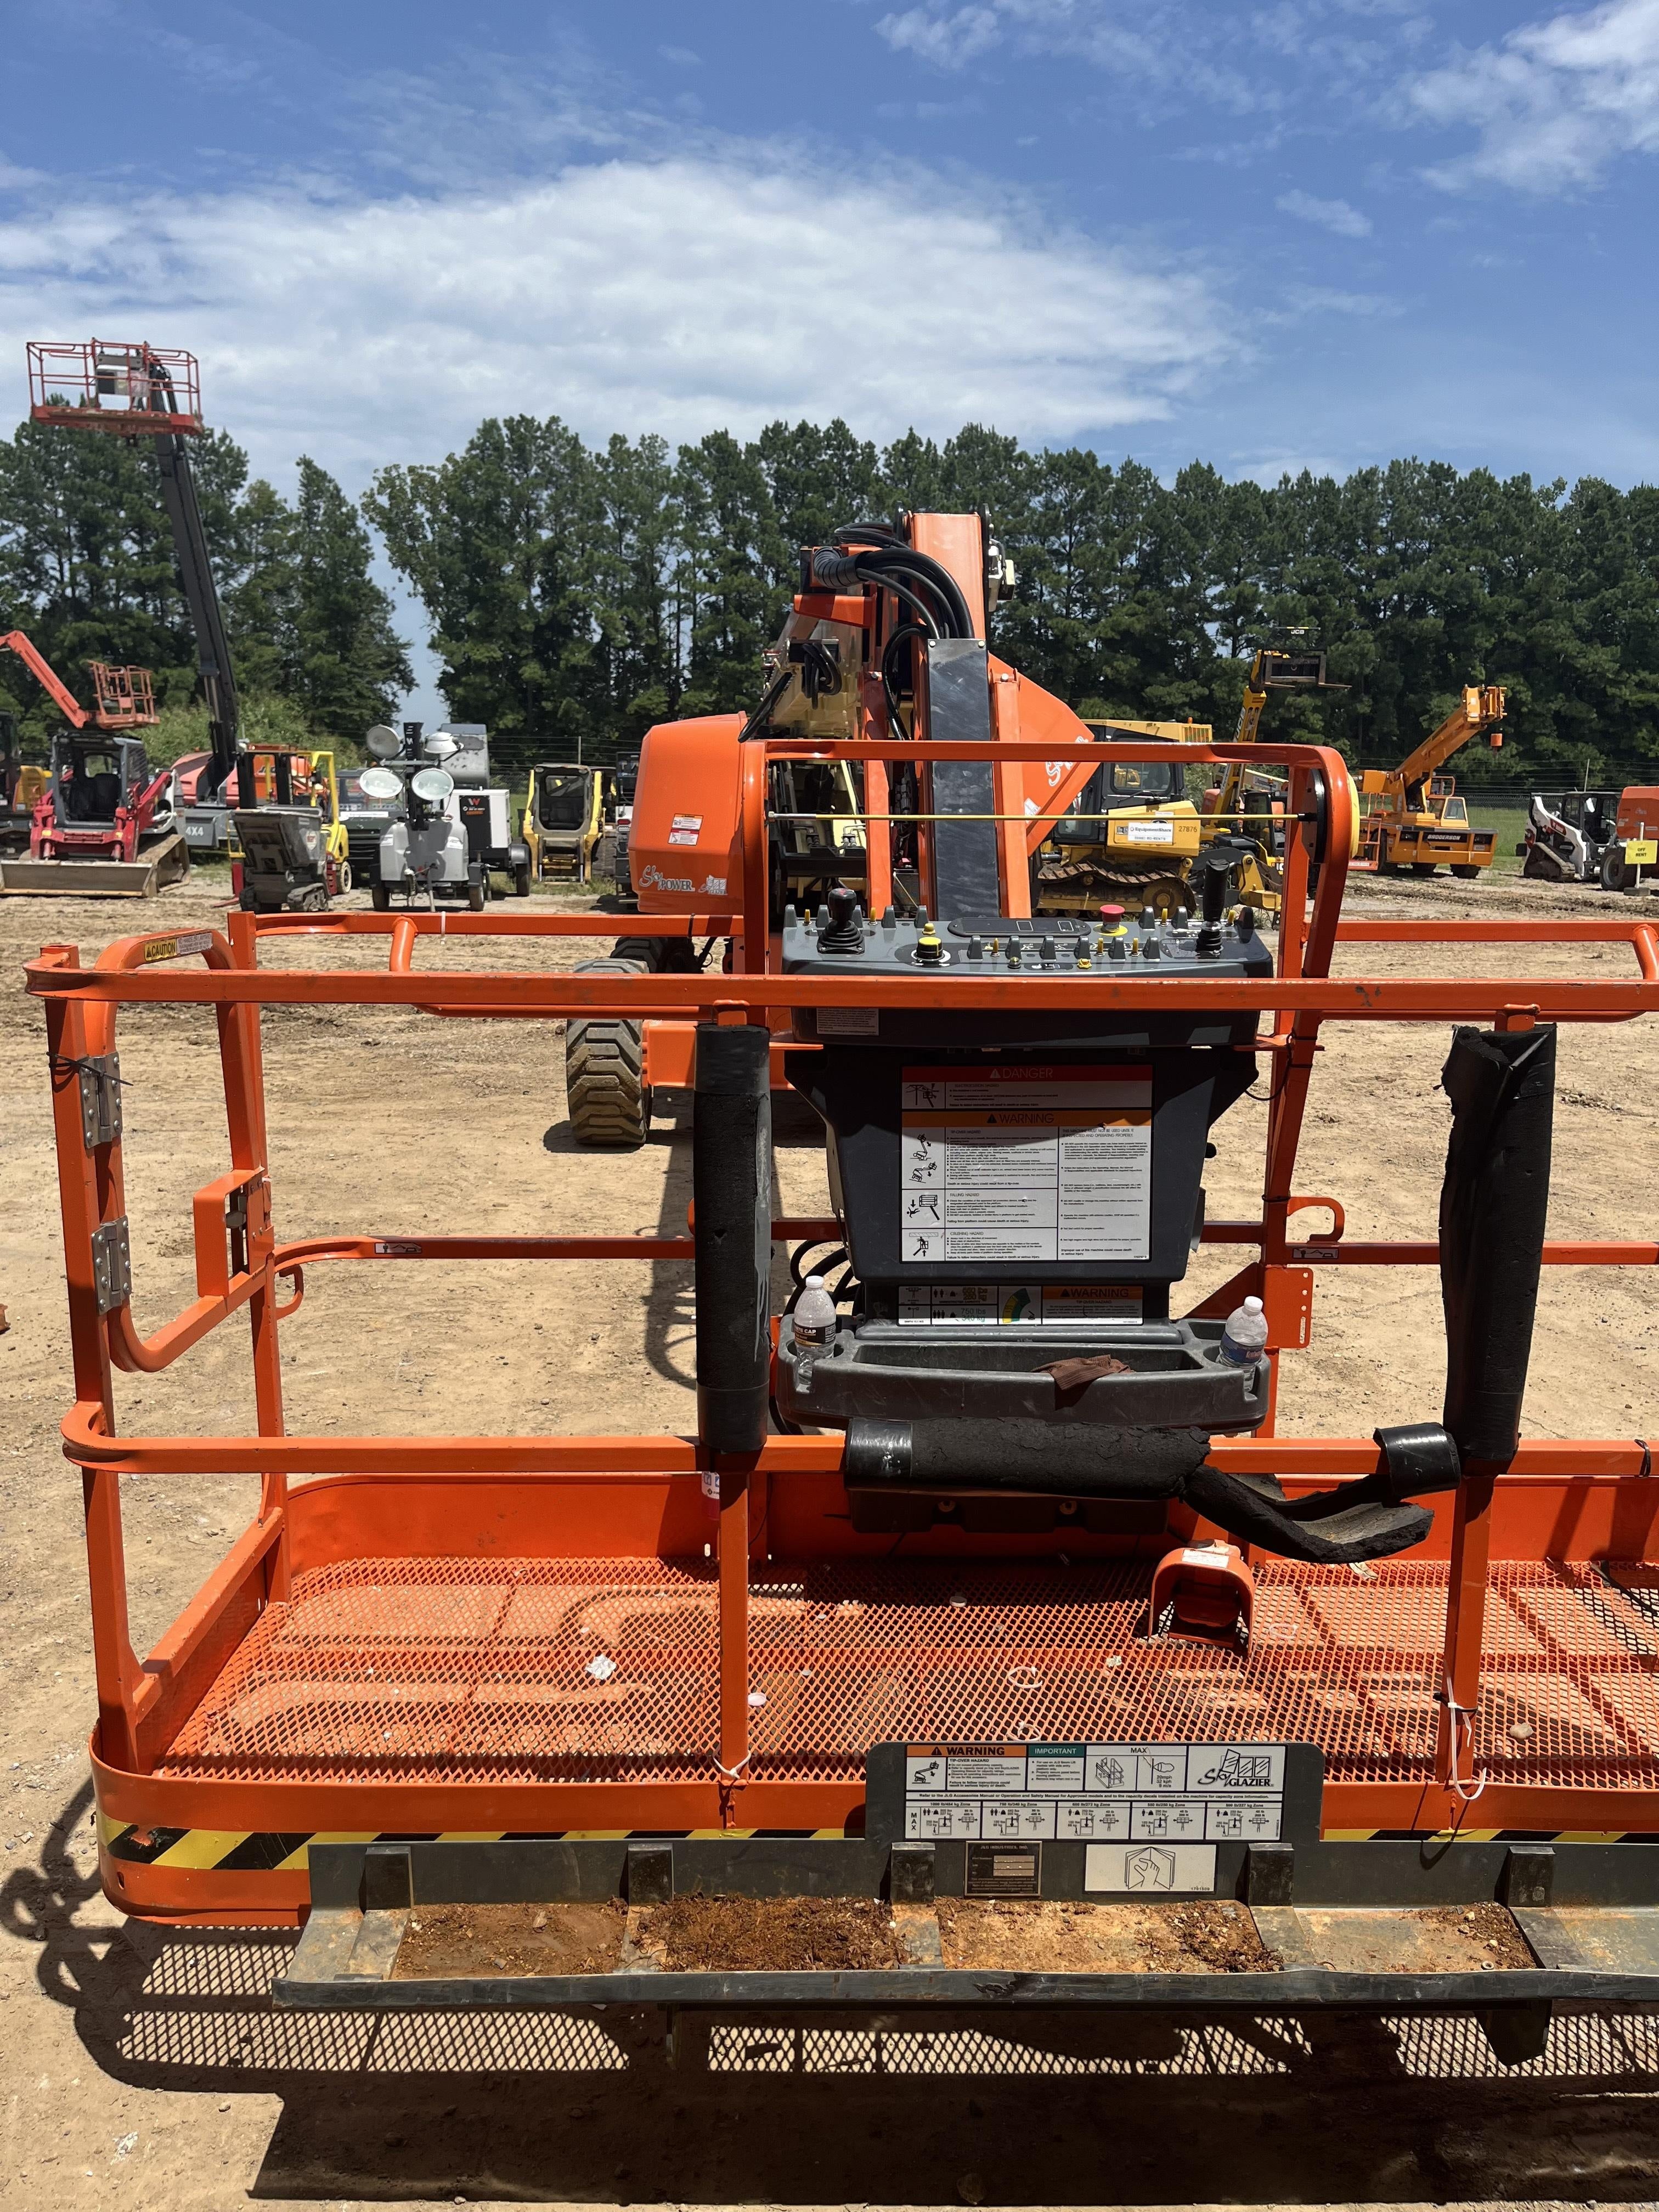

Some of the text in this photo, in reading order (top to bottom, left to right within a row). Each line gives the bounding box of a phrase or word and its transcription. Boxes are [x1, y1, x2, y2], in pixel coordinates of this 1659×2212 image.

[185, 825, 204, 837] 4X4
[151, 942, 176, 956] CAUTION
[1003, 1068, 1053, 1078] DANGER
[1000, 1114, 1054, 1124] WARNING
[1070, 1288, 1128, 1297] WARNING
[946, 1747, 1005, 1756] WARNING
